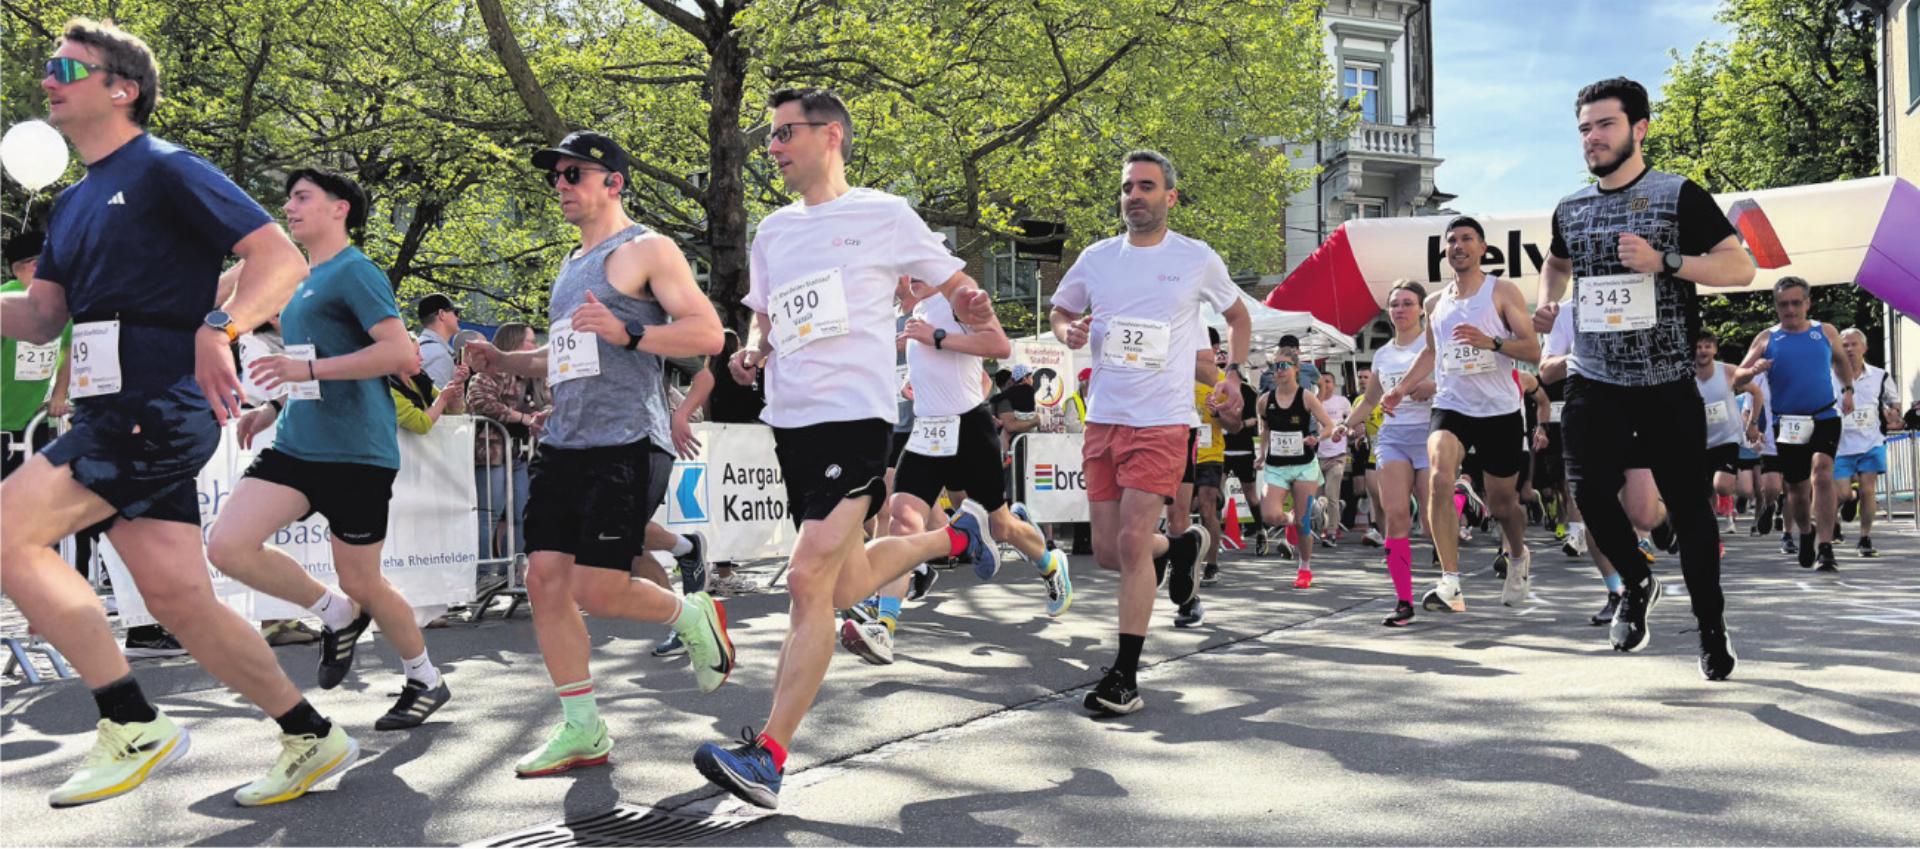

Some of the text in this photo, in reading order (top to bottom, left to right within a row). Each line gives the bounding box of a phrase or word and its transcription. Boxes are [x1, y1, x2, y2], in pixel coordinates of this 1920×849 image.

[783, 290, 819, 319] 190
[1595, 288, 1632, 306] 343
[552, 333, 577, 355] 196
[1122, 329, 1144, 345] 32
[923, 426, 946, 439] 246
[722, 463, 784, 490] Aargau
[408, 552, 476, 567] Rheinfelden
